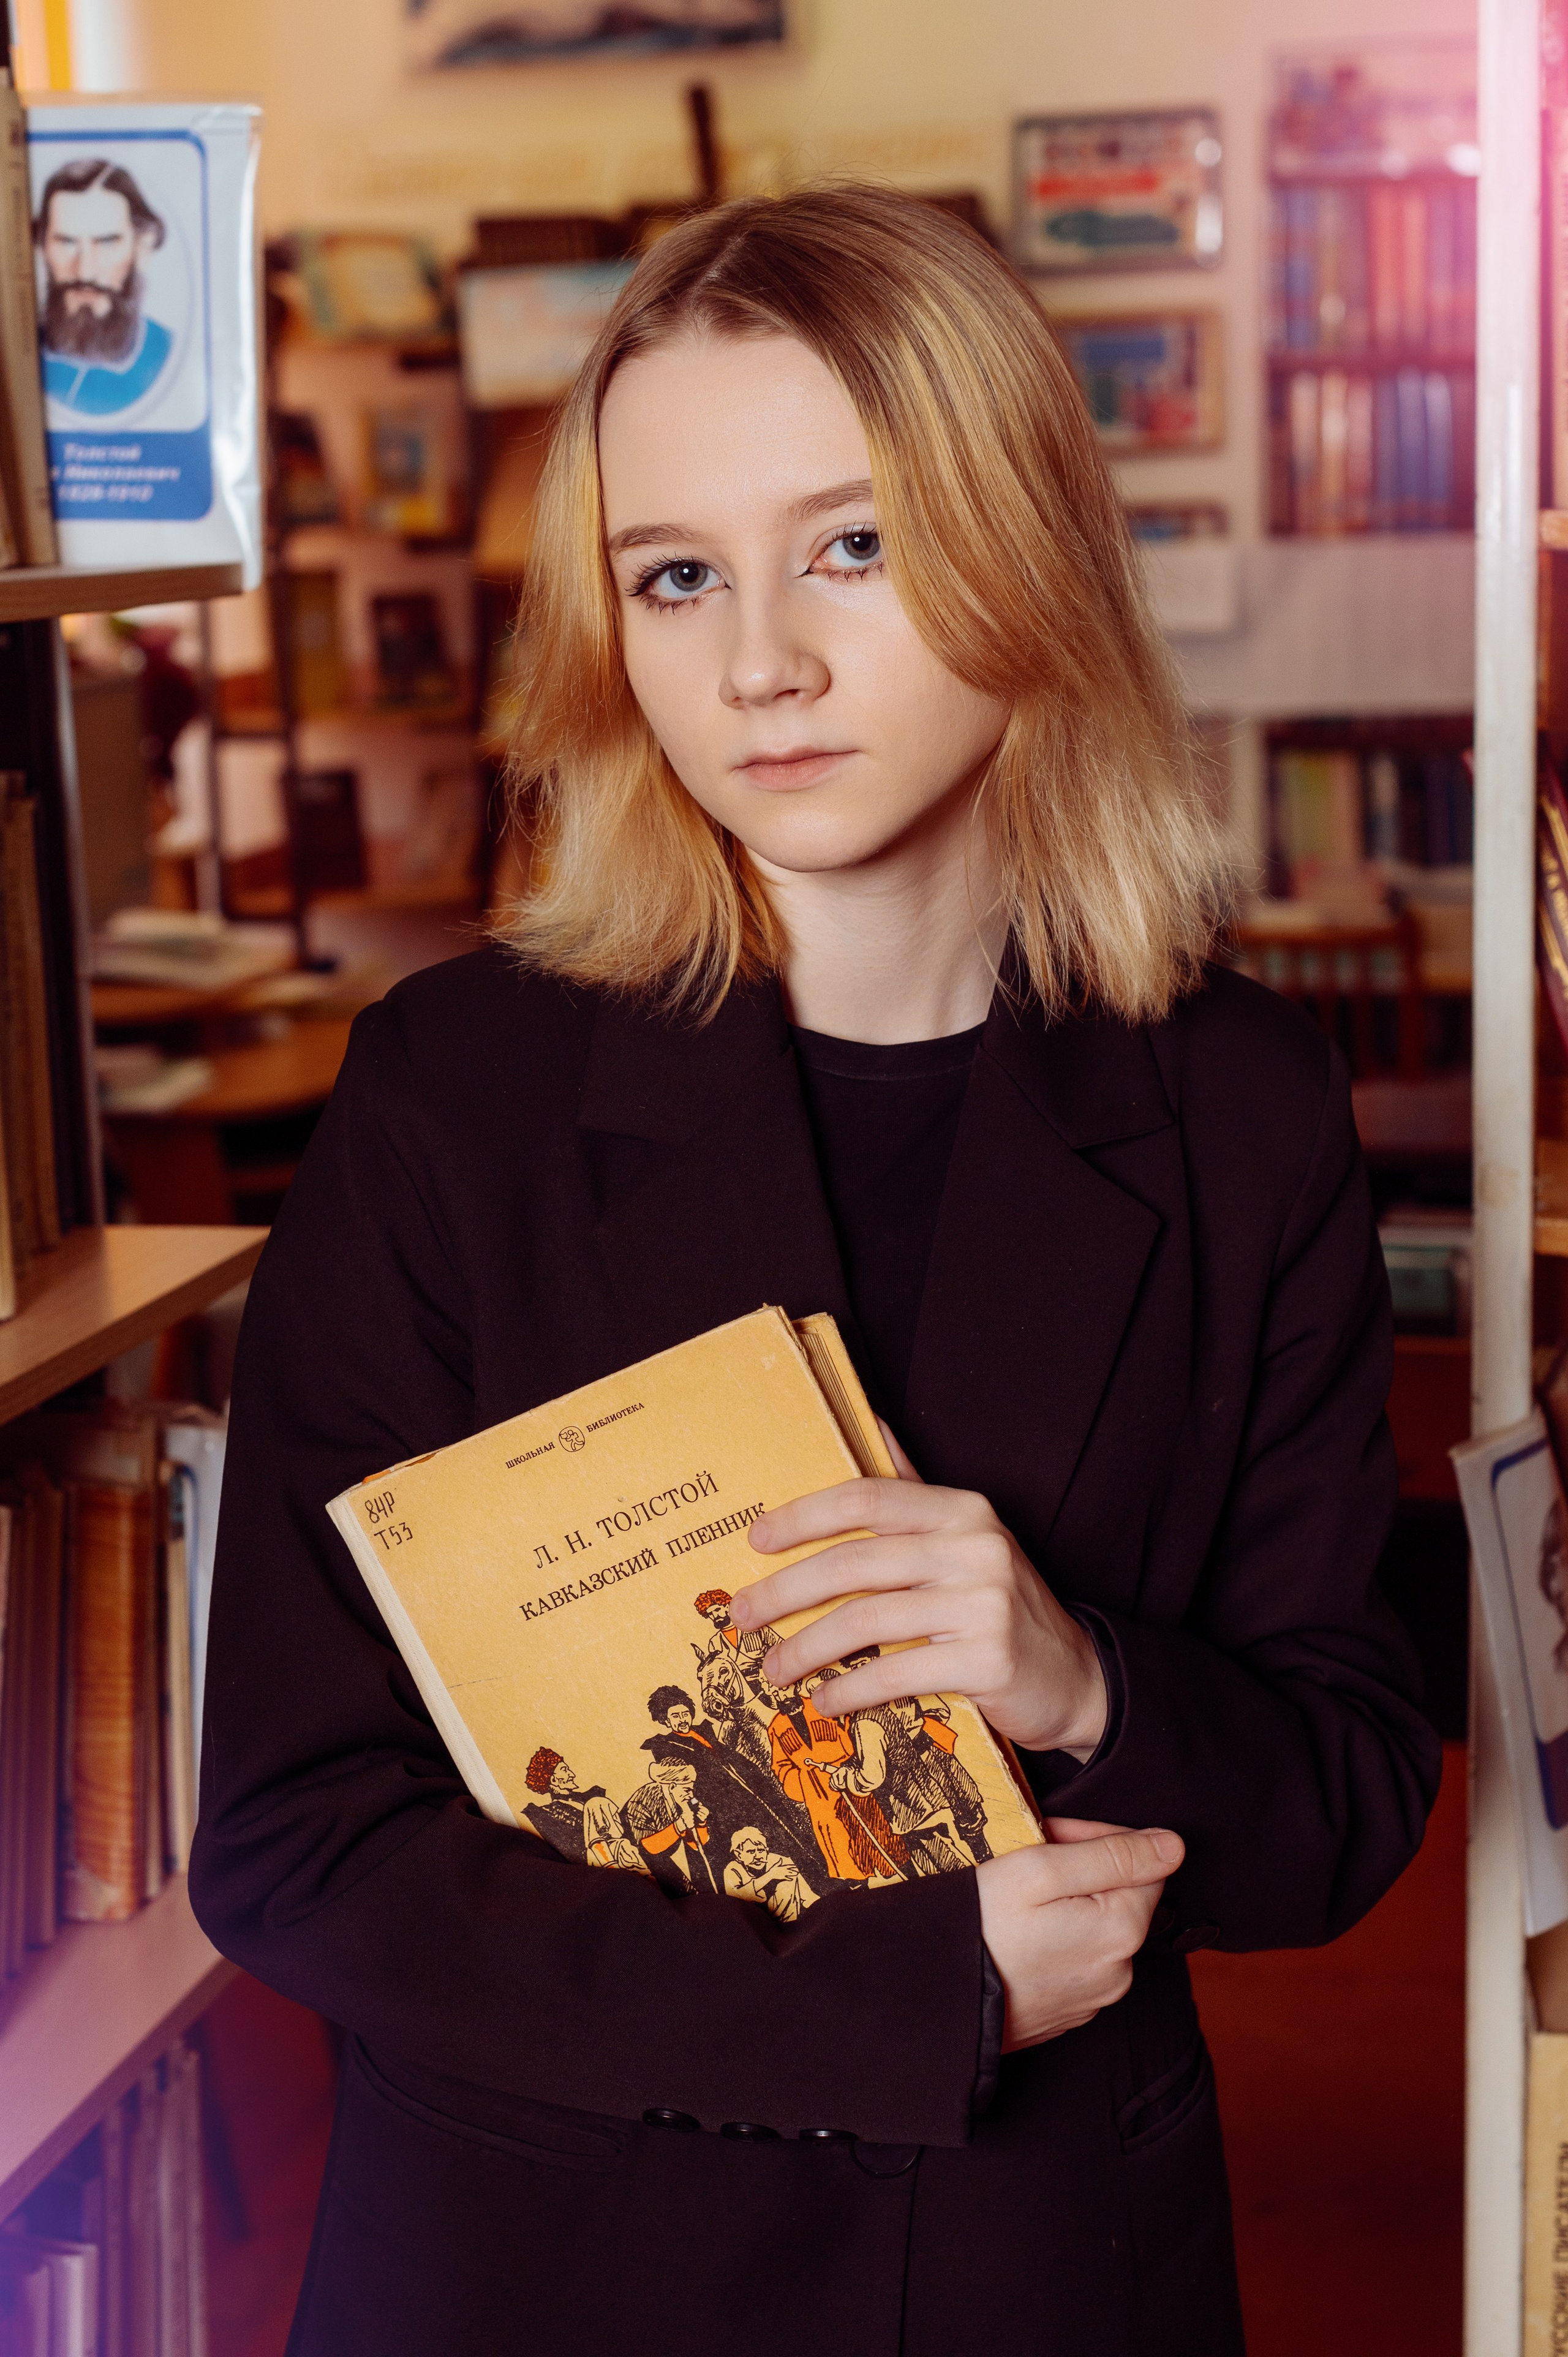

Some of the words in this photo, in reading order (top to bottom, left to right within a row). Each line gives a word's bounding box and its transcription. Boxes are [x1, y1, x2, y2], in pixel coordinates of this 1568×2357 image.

[505, 1441, 556, 1469] ШКОЛЬНАЯ
[586, 1403, 645, 1433] БИБЛИОТЕКА
[374, 1522, 413, 1550] Т53
[533, 1545, 559, 1569] Л.
[564, 1531, 592, 1554] Н.
[596, 1470, 720, 1539] ТОЛСТОЙ
[519, 1548, 660, 1621] КАВКАЗСКИЙ
